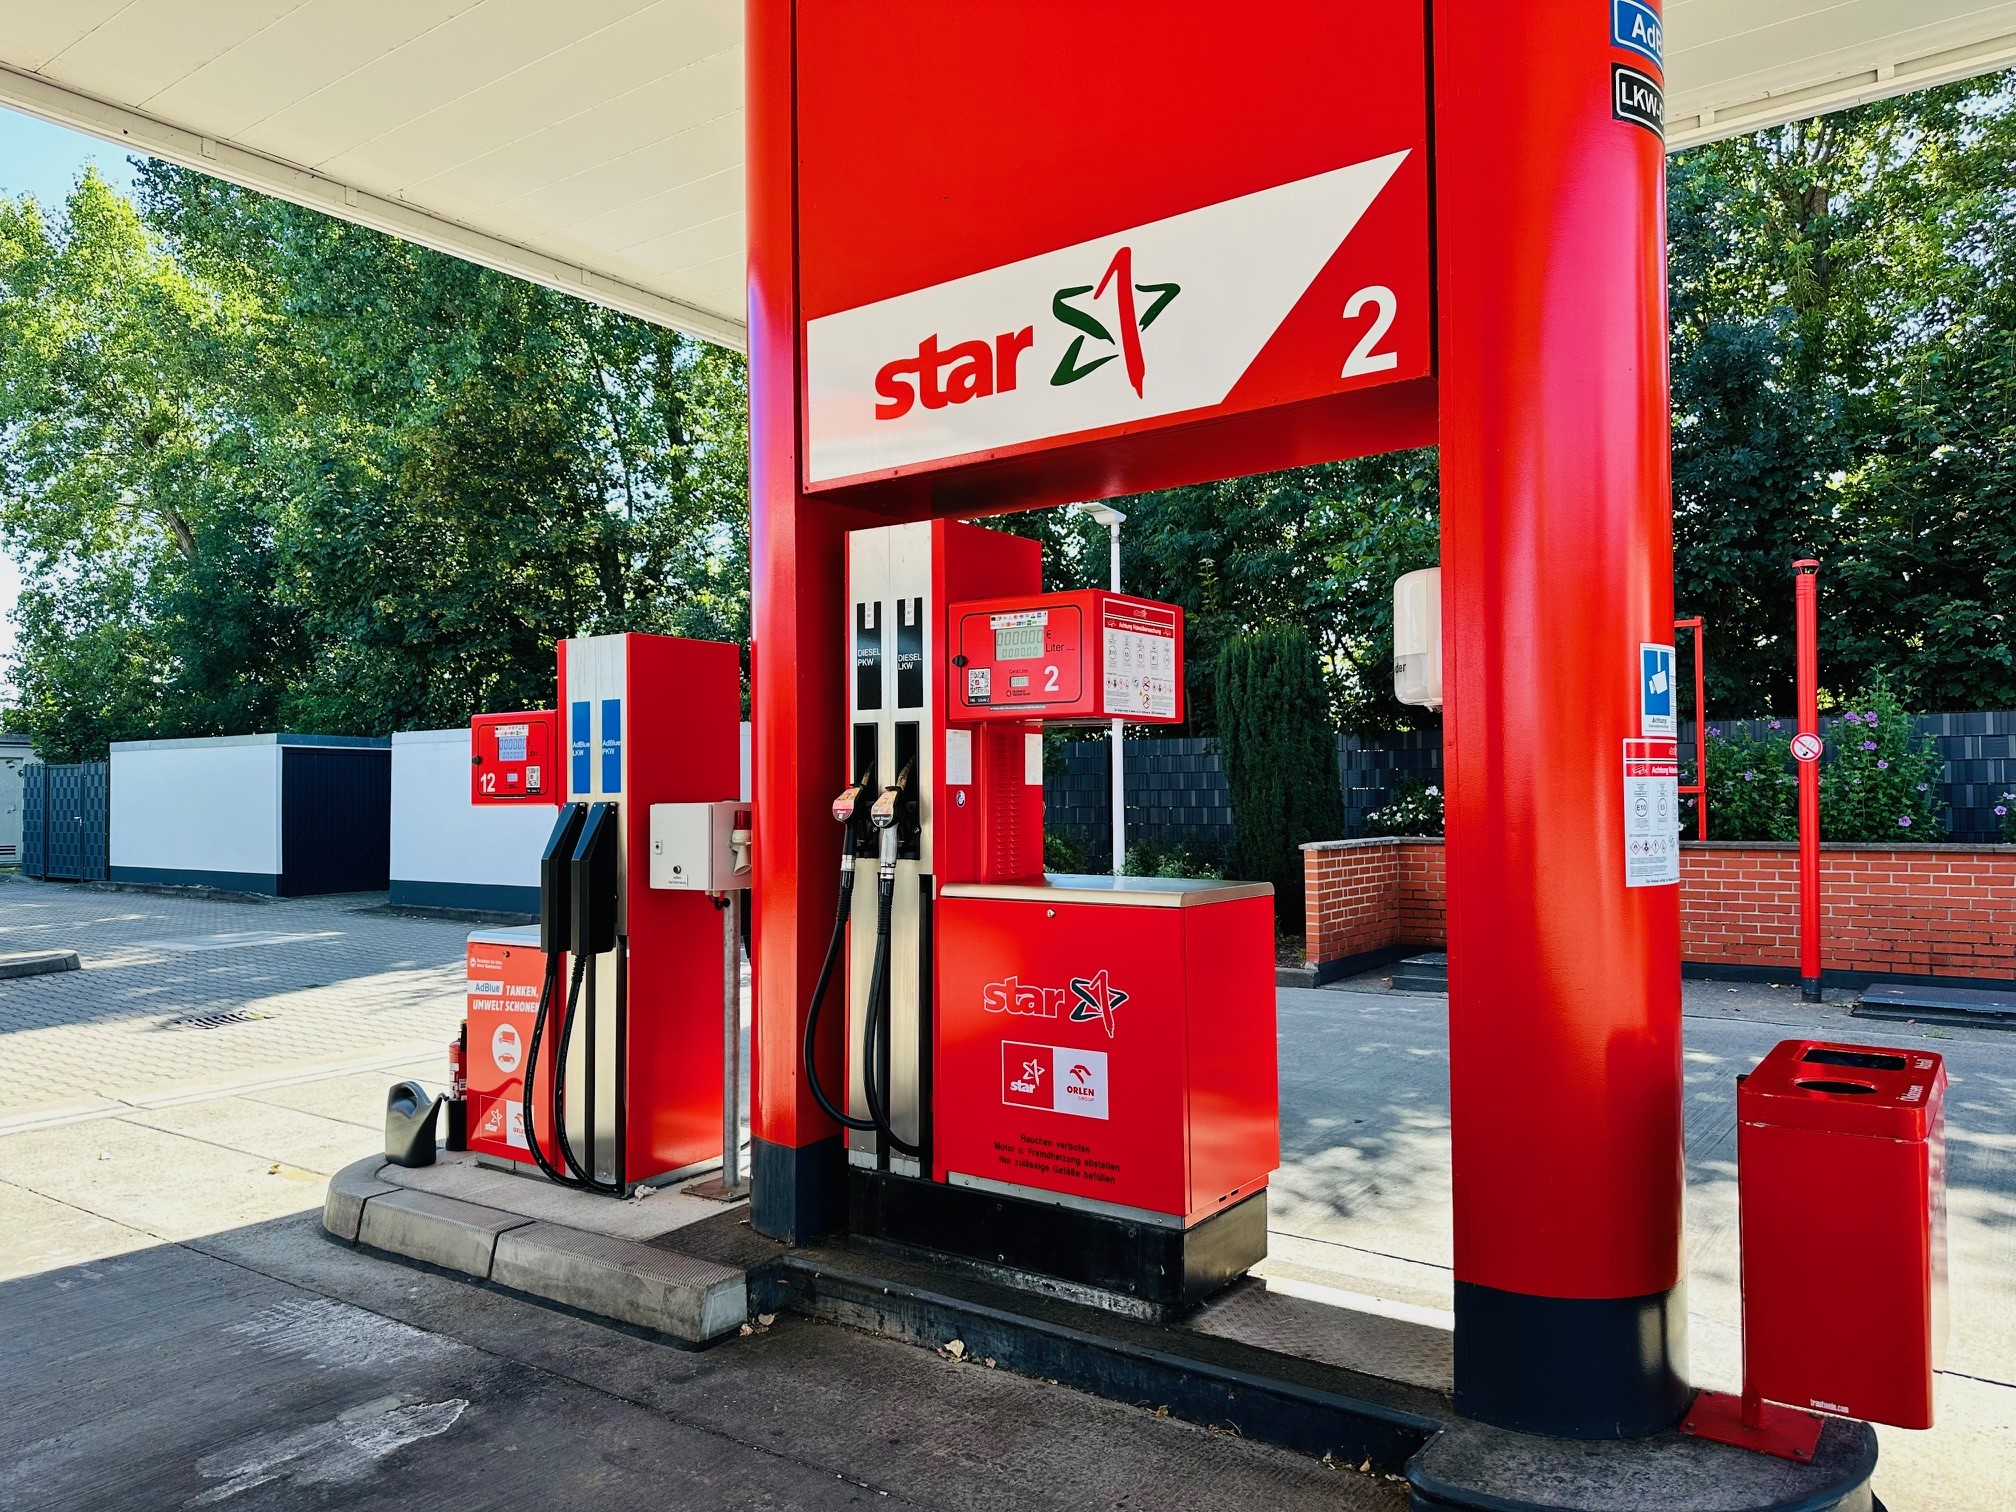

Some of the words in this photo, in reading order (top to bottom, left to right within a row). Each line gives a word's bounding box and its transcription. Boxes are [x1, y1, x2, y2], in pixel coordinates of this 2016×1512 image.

[1341, 285, 1398, 379] 2
[875, 325, 1033, 420] star
[857, 648, 881, 657] DIESEL
[1046, 643, 1064, 652] Liter
[857, 658, 874, 667] PKW
[898, 653, 922, 662] DIESEL
[898, 661, 914, 671] LKW
[1044, 665, 1059, 692] 2
[480, 772, 496, 793] 12
[476, 983, 500, 993] AdBlue
[506, 985, 538, 998] TANKEN,
[983, 975, 1065, 1018] star
[473, 1000, 504, 1011] UMWELT
[1010, 1080, 1036, 1094] star
[1066, 1085, 1095, 1097] ORLEN
[1020, 1134, 1053, 1147] Rauchen
[1056, 1141, 1091, 1153] verboten
[994, 1142, 1015, 1152] Motor
[1028, 1148, 1081, 1166] Fremdheizung
[1084, 1158, 1120, 1172] abstellen
[999, 1155, 1011, 1164] Nur
[1015, 1158, 1049, 1172] zulässige
[1052, 1165, 1080, 1177] Gefäße
[1084, 1170, 1115, 1183] befüllen
